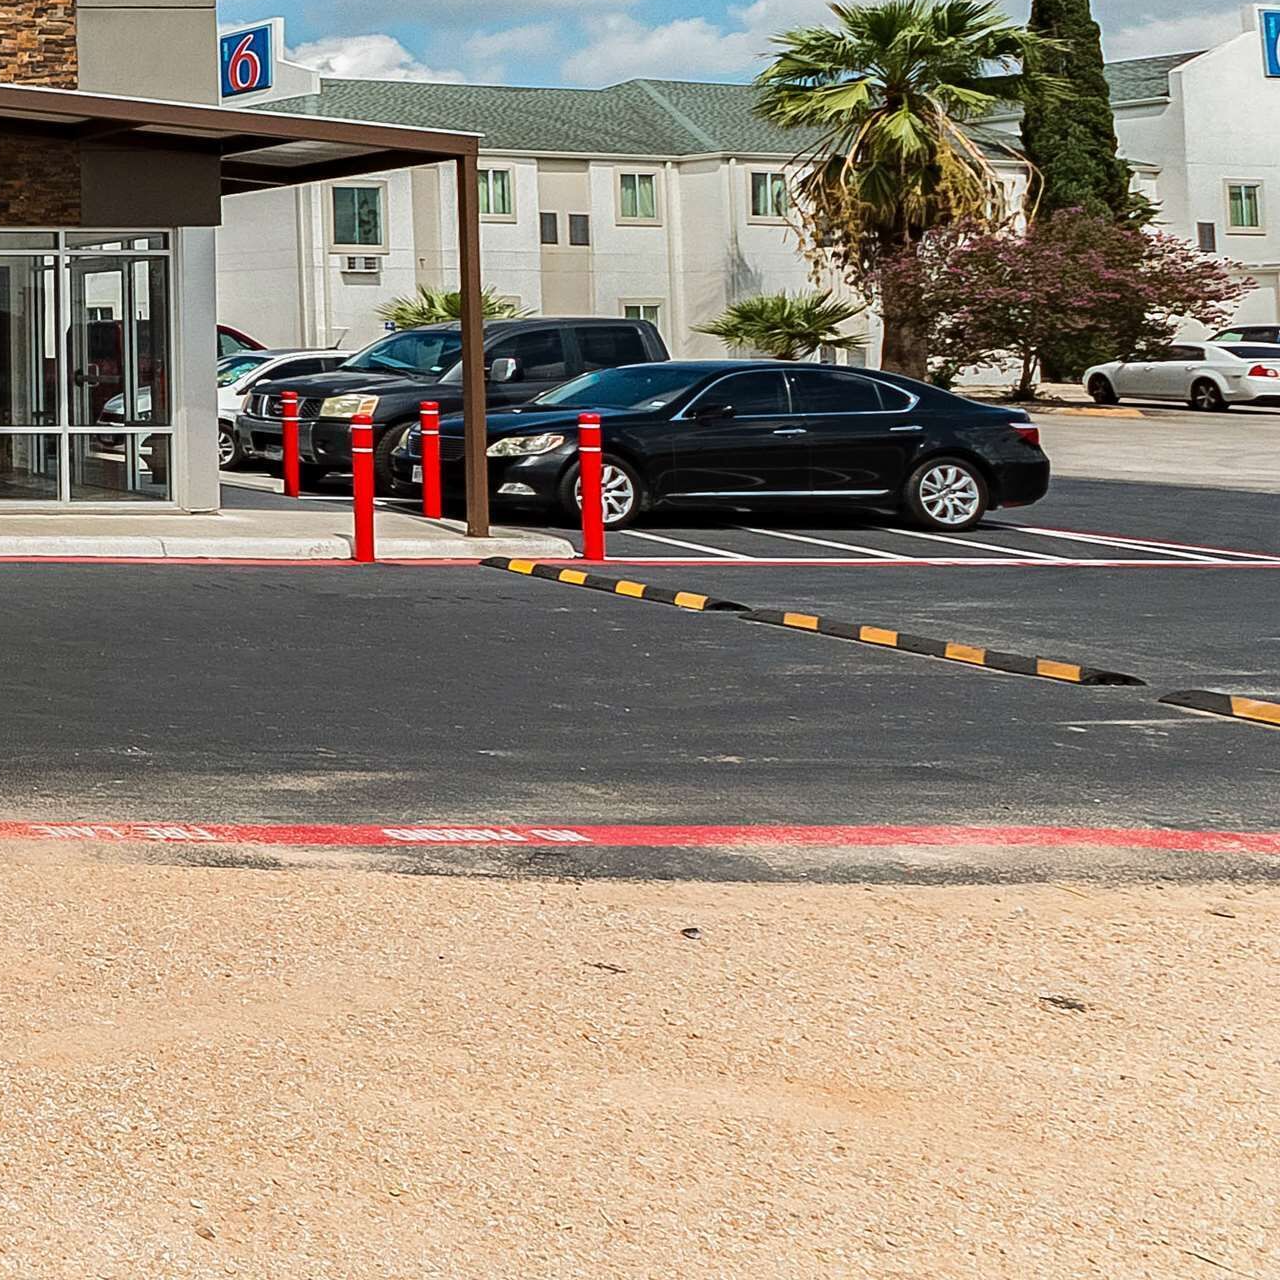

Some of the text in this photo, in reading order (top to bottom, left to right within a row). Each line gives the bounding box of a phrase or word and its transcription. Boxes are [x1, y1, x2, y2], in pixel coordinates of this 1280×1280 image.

[228, 33, 261, 91] 6
[30, 825, 216, 840] FIRE LANE
[382, 828, 592, 842] NO PARKING
